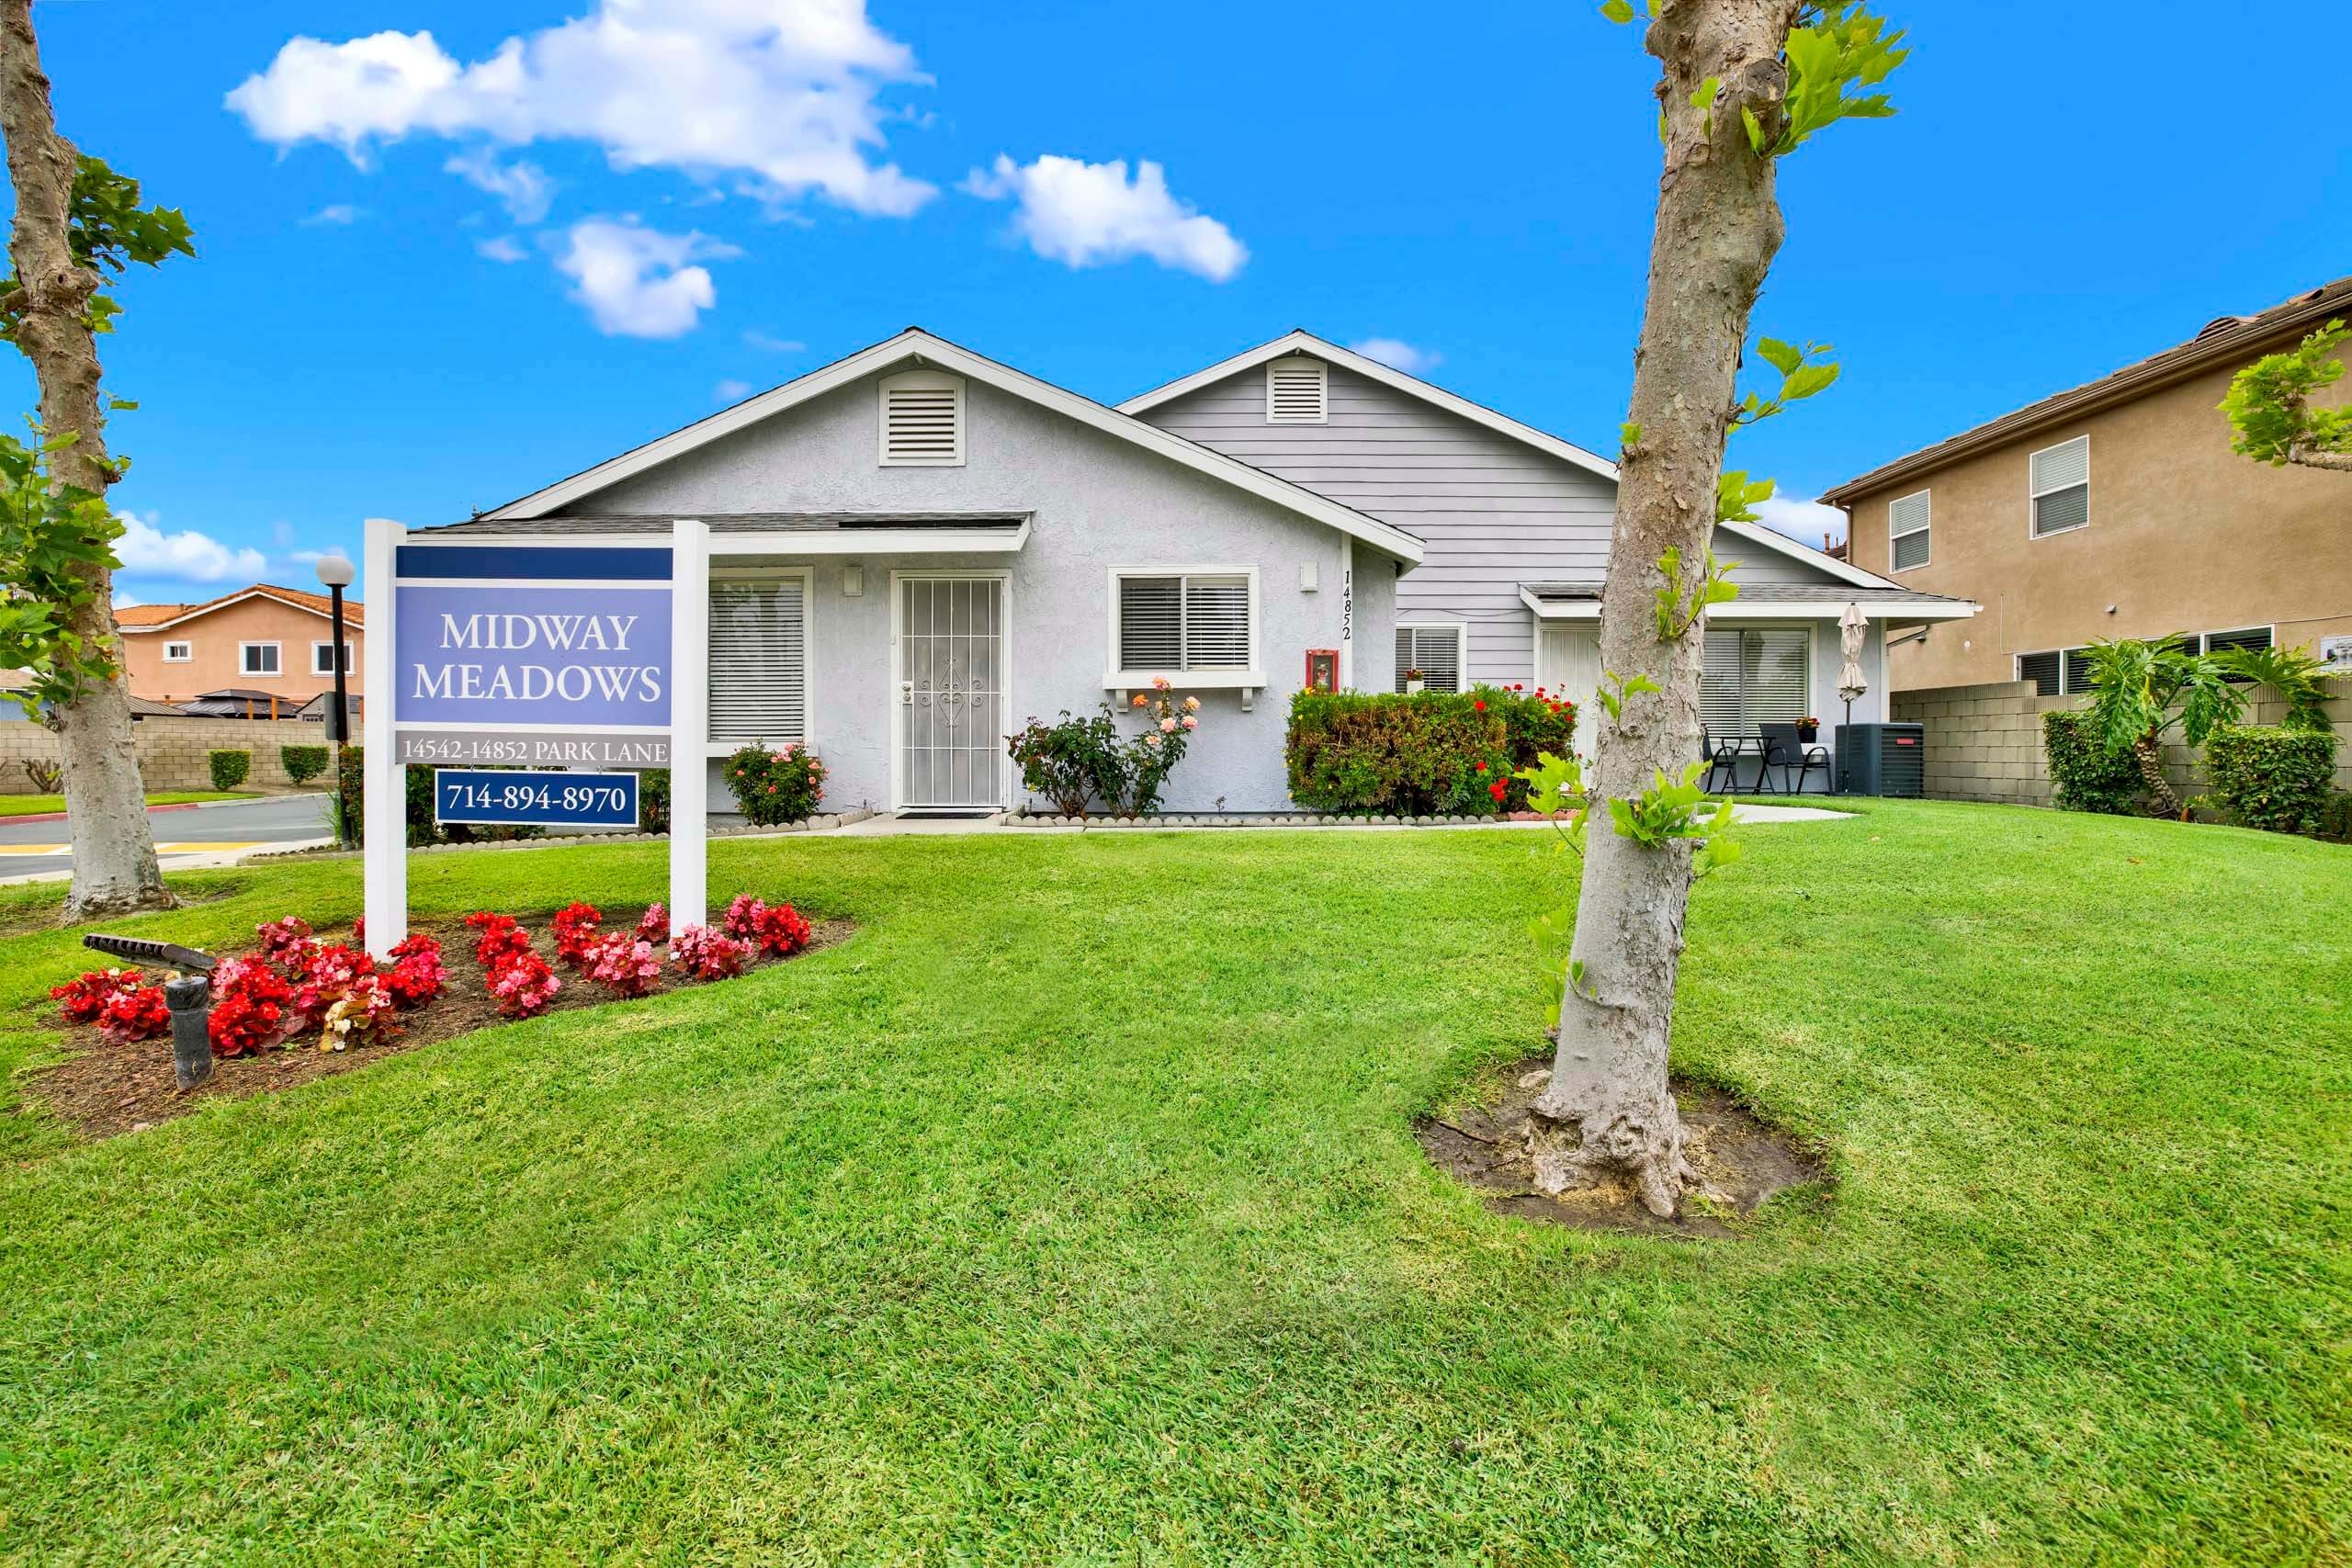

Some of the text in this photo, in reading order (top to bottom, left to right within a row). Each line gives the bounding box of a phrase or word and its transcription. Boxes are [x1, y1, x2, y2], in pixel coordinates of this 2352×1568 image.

[1342, 570, 1351, 640] 14852
[439, 613, 639, 650] MIDWAY
[412, 663, 662, 703] MEADOWS
[404, 738, 669, 763] 14542-14852 PARK LANE
[447, 783, 627, 813] 714-894-8970
